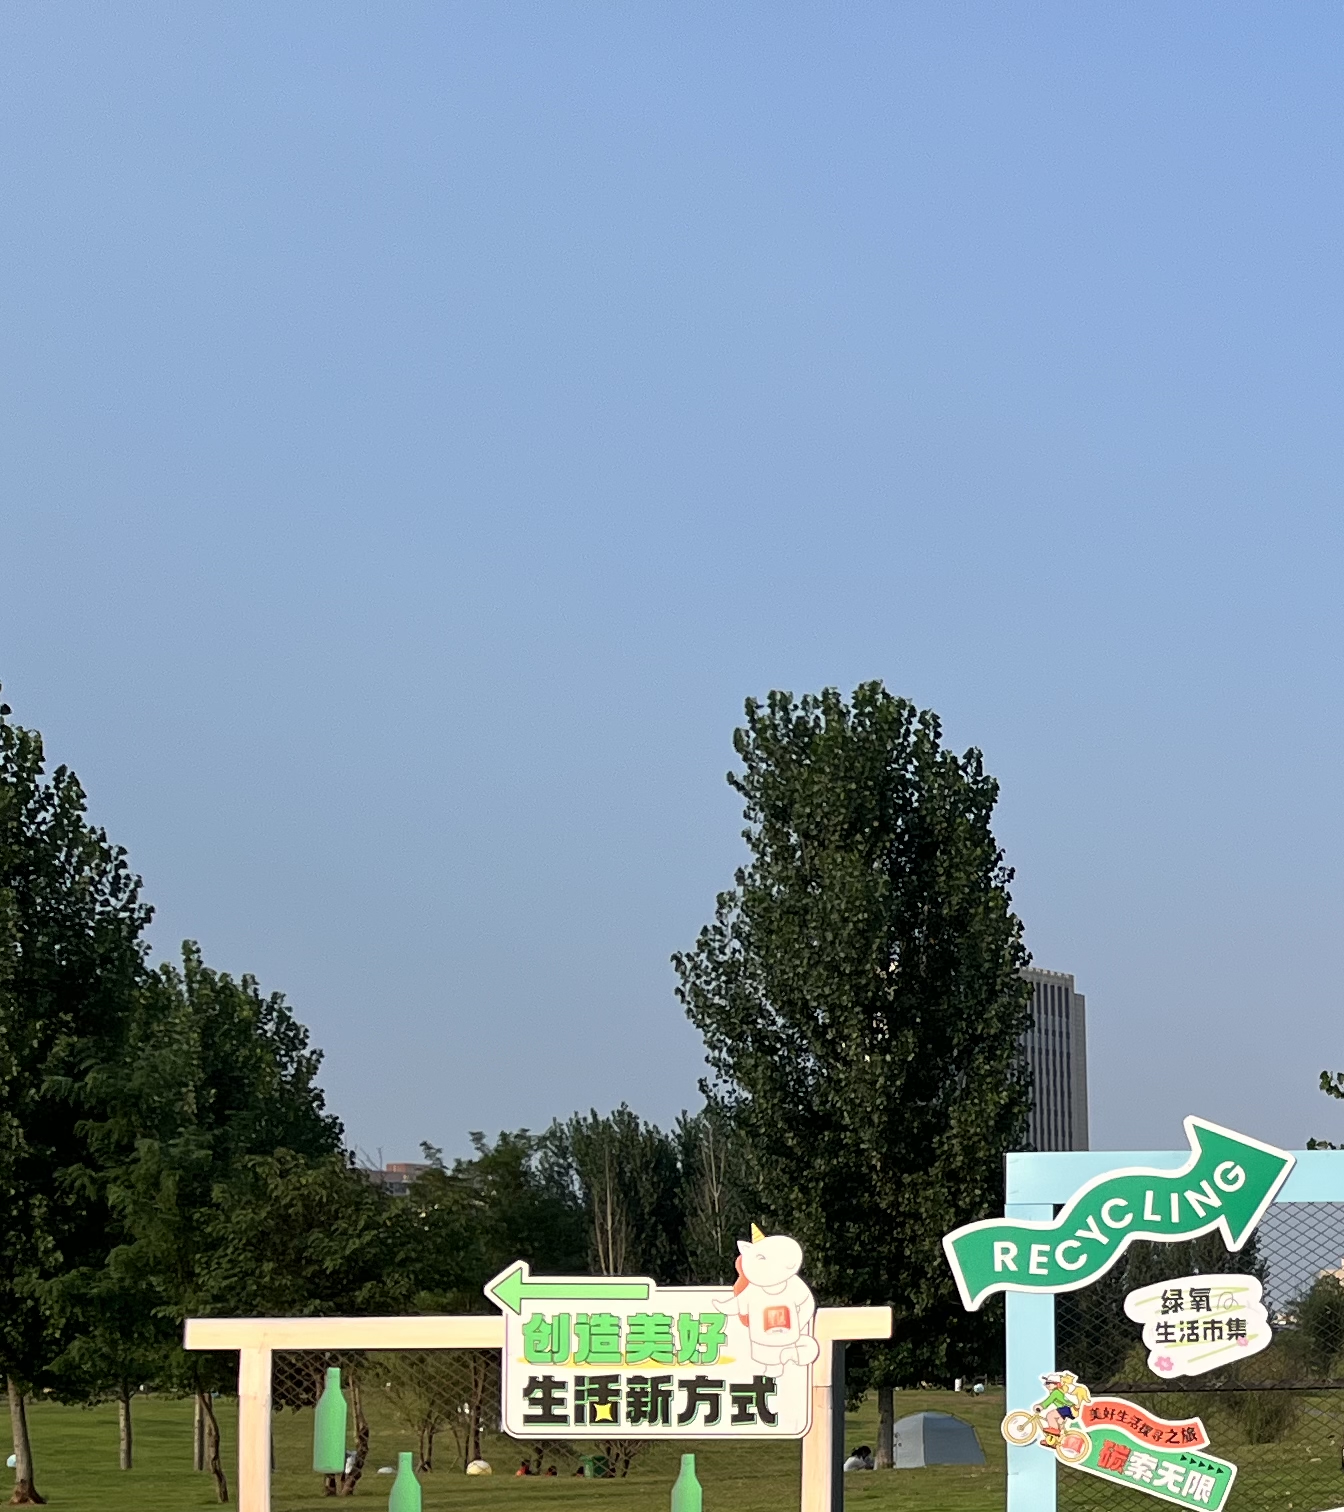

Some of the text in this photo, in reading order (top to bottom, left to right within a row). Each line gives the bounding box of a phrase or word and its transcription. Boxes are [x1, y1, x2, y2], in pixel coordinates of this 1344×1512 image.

[993, 1160, 1246, 1275] RECYCLING
[1161, 1287, 1212, 1314] 绿氧
[522, 1312, 729, 1365] 创造美好
[1155, 1318, 1247, 1343] 生活市集
[523, 1375, 778, 1427] 生活新方式
[1097, 1439, 1217, 1504] 碳索无限
